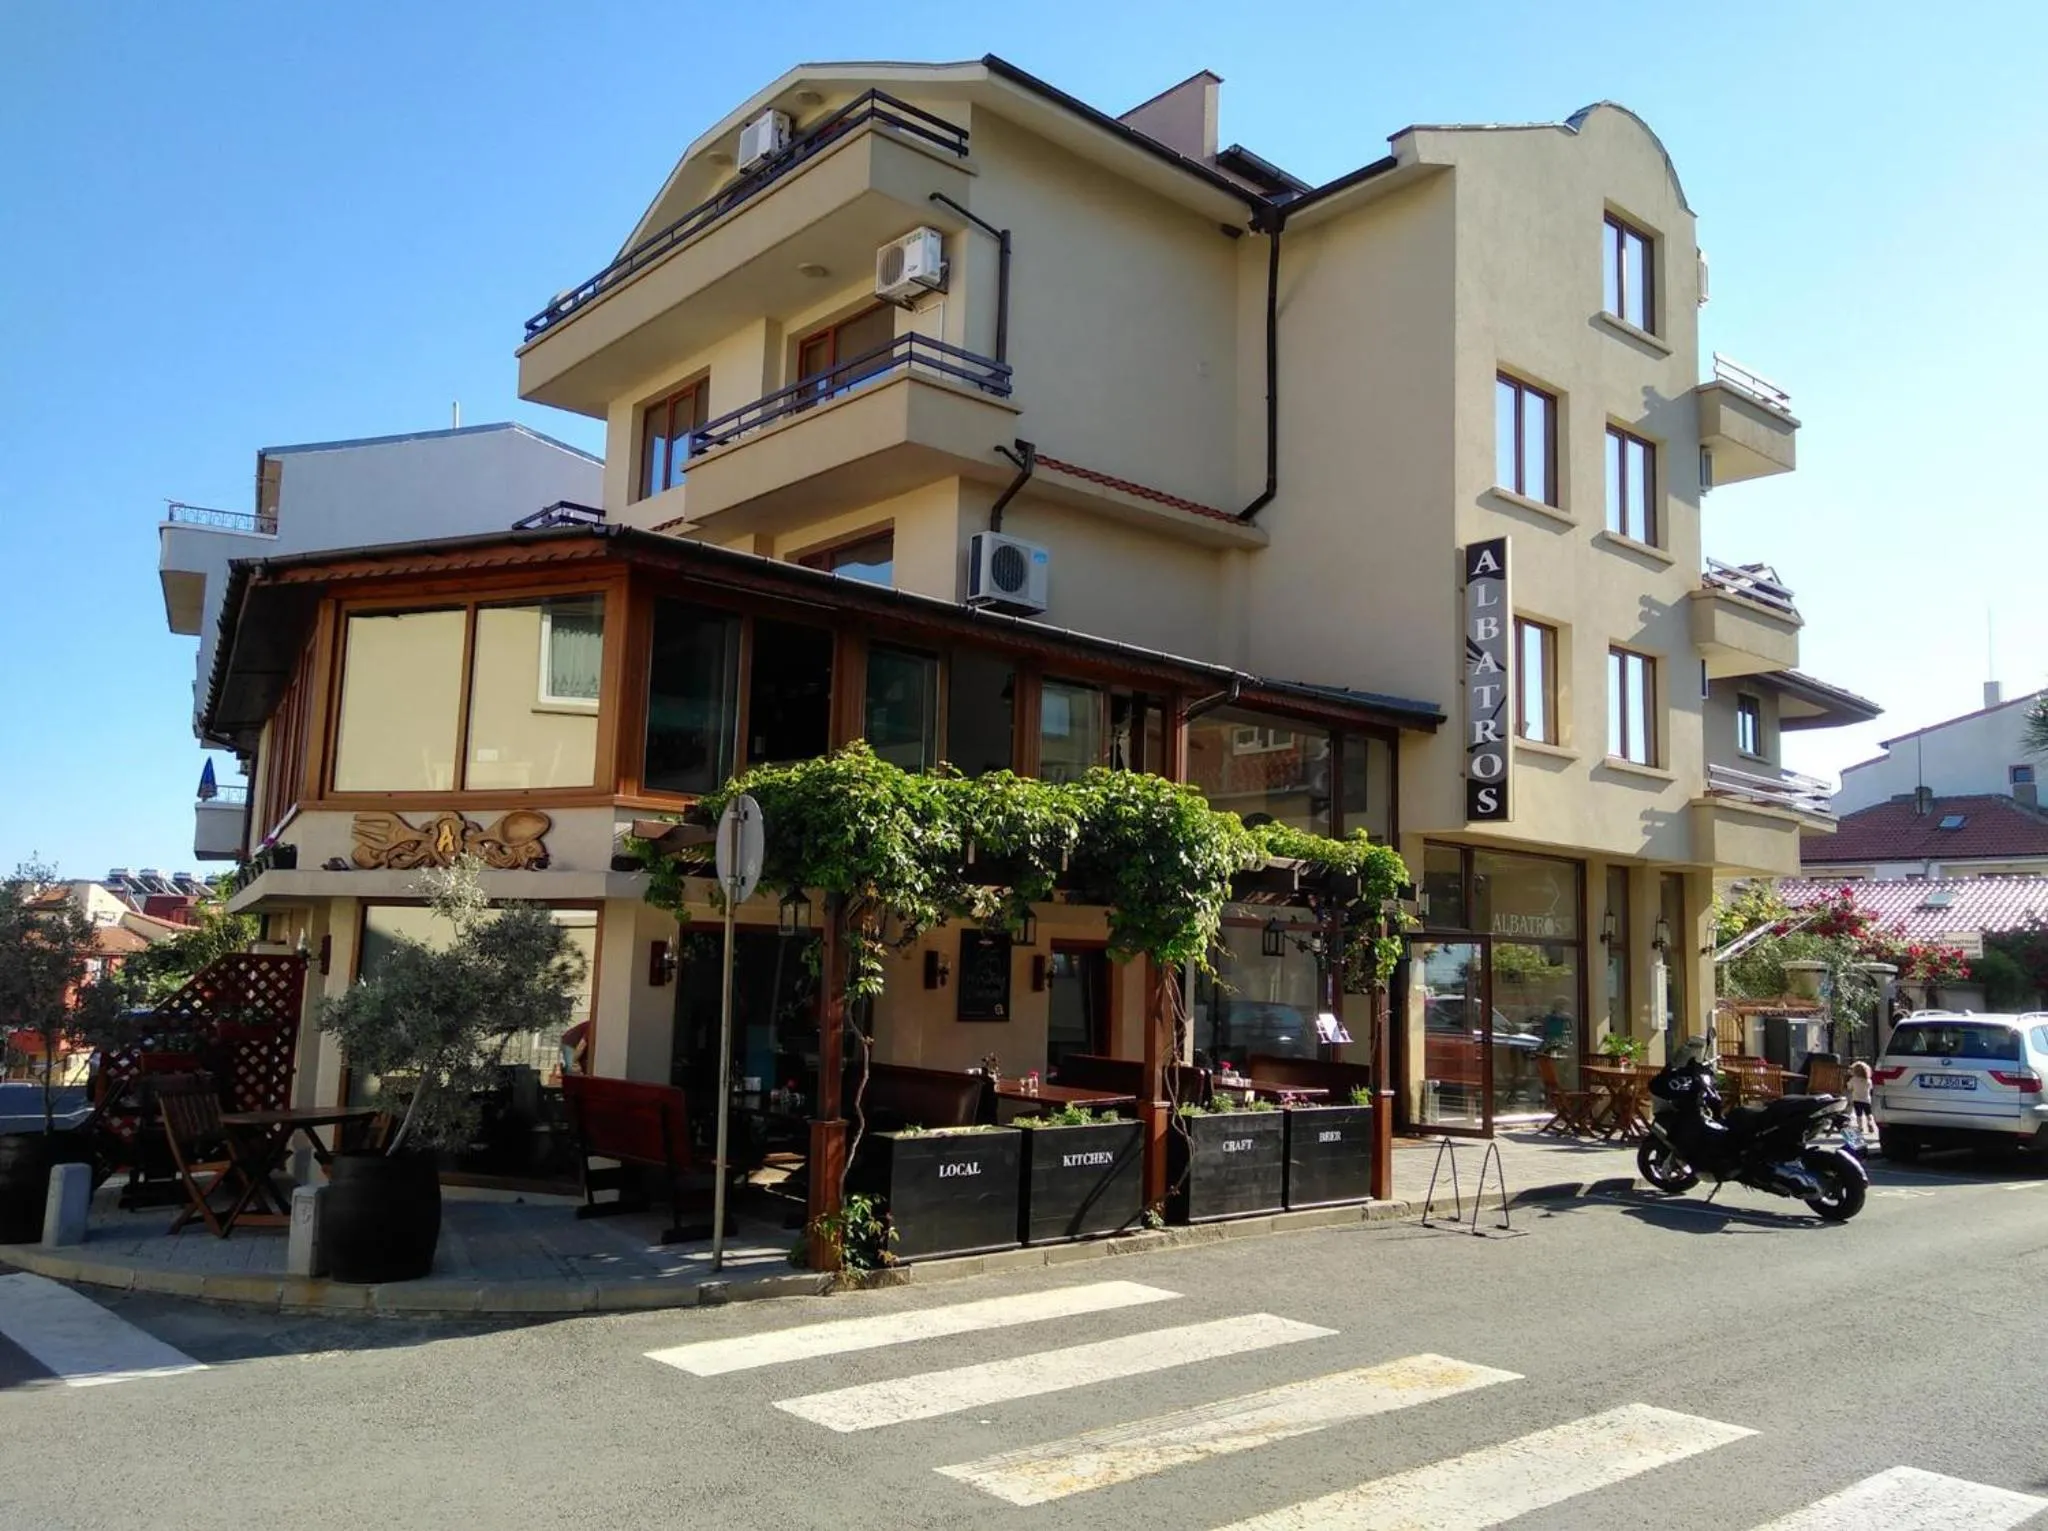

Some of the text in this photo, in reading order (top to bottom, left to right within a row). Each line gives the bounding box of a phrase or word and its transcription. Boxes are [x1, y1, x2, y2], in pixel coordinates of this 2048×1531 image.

[1471, 549, 1503, 814] ALBATROS
[437, 823, 455, 852] A
[1319, 1130, 1341, 1142] BEER
[1222, 1138, 1253, 1152] CRAFT
[1062, 1151, 1114, 1167] KITCHEN
[938, 1161, 982, 1178] LOCAL
